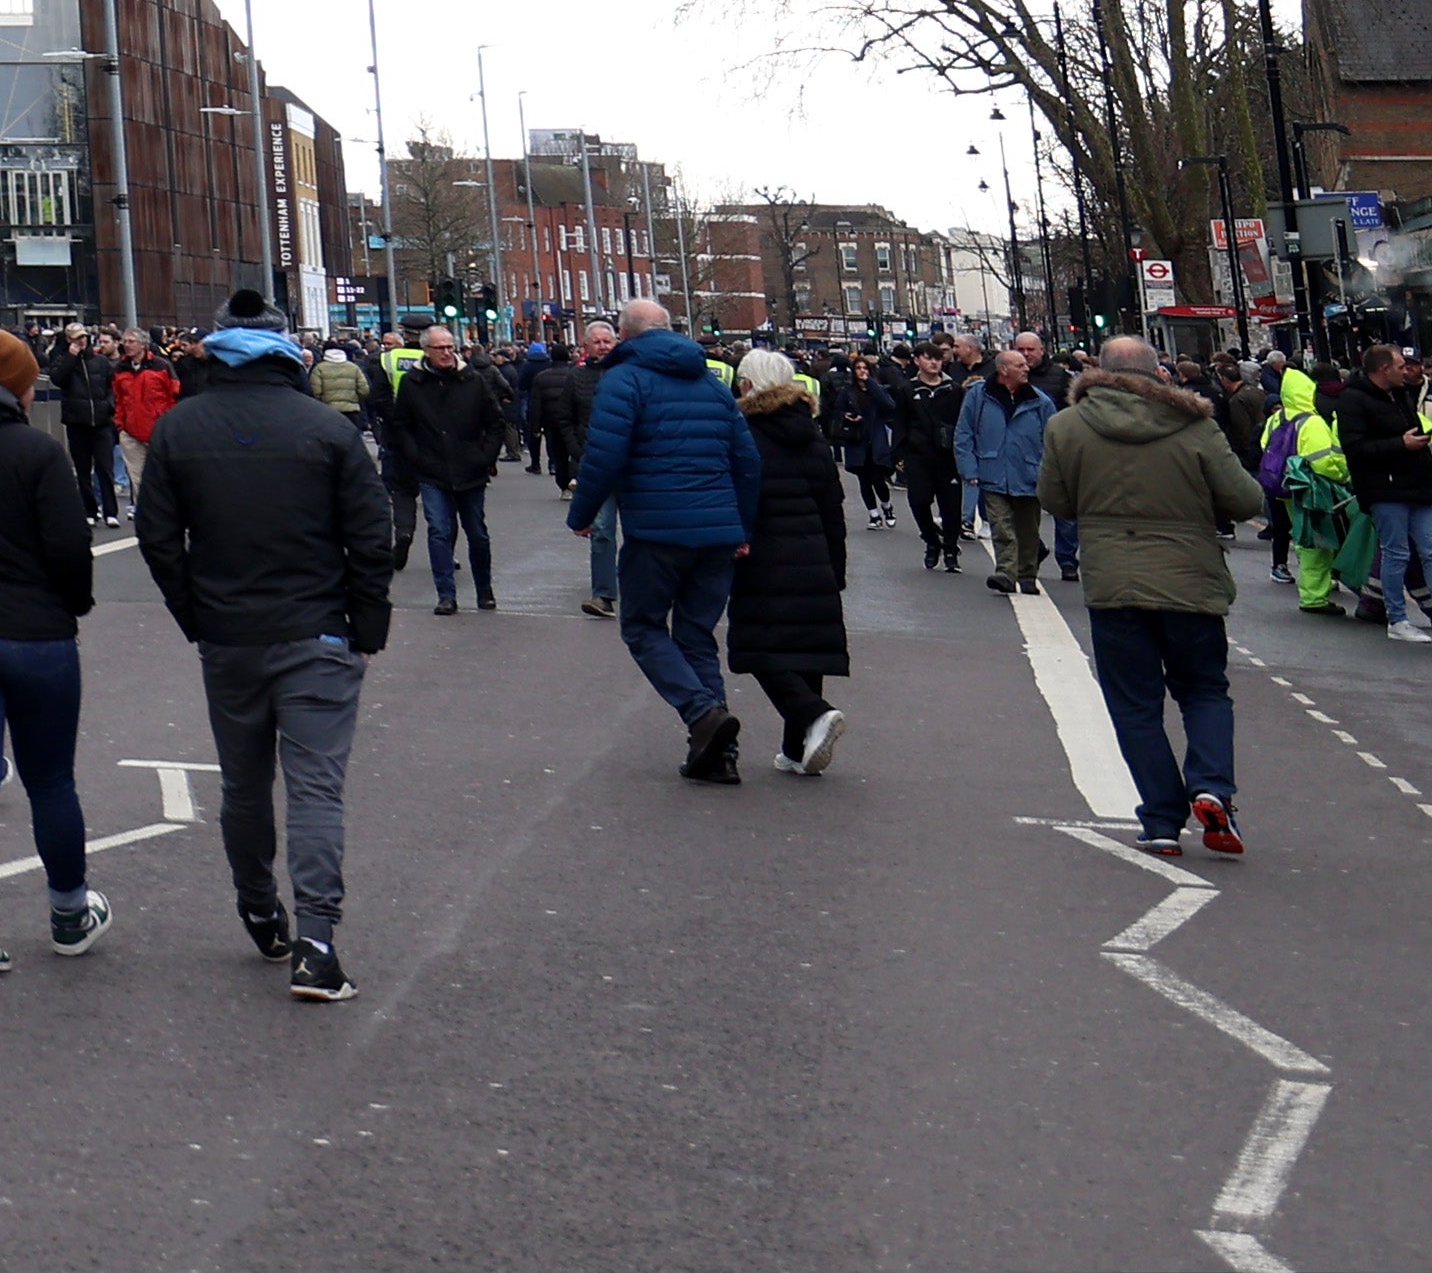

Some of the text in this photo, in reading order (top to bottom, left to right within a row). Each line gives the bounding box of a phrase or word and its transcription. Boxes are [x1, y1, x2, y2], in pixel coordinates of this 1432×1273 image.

[270, 123, 293, 267] TOTTENHAM EXPERIENCE
[1132, 248, 1142, 259] T
